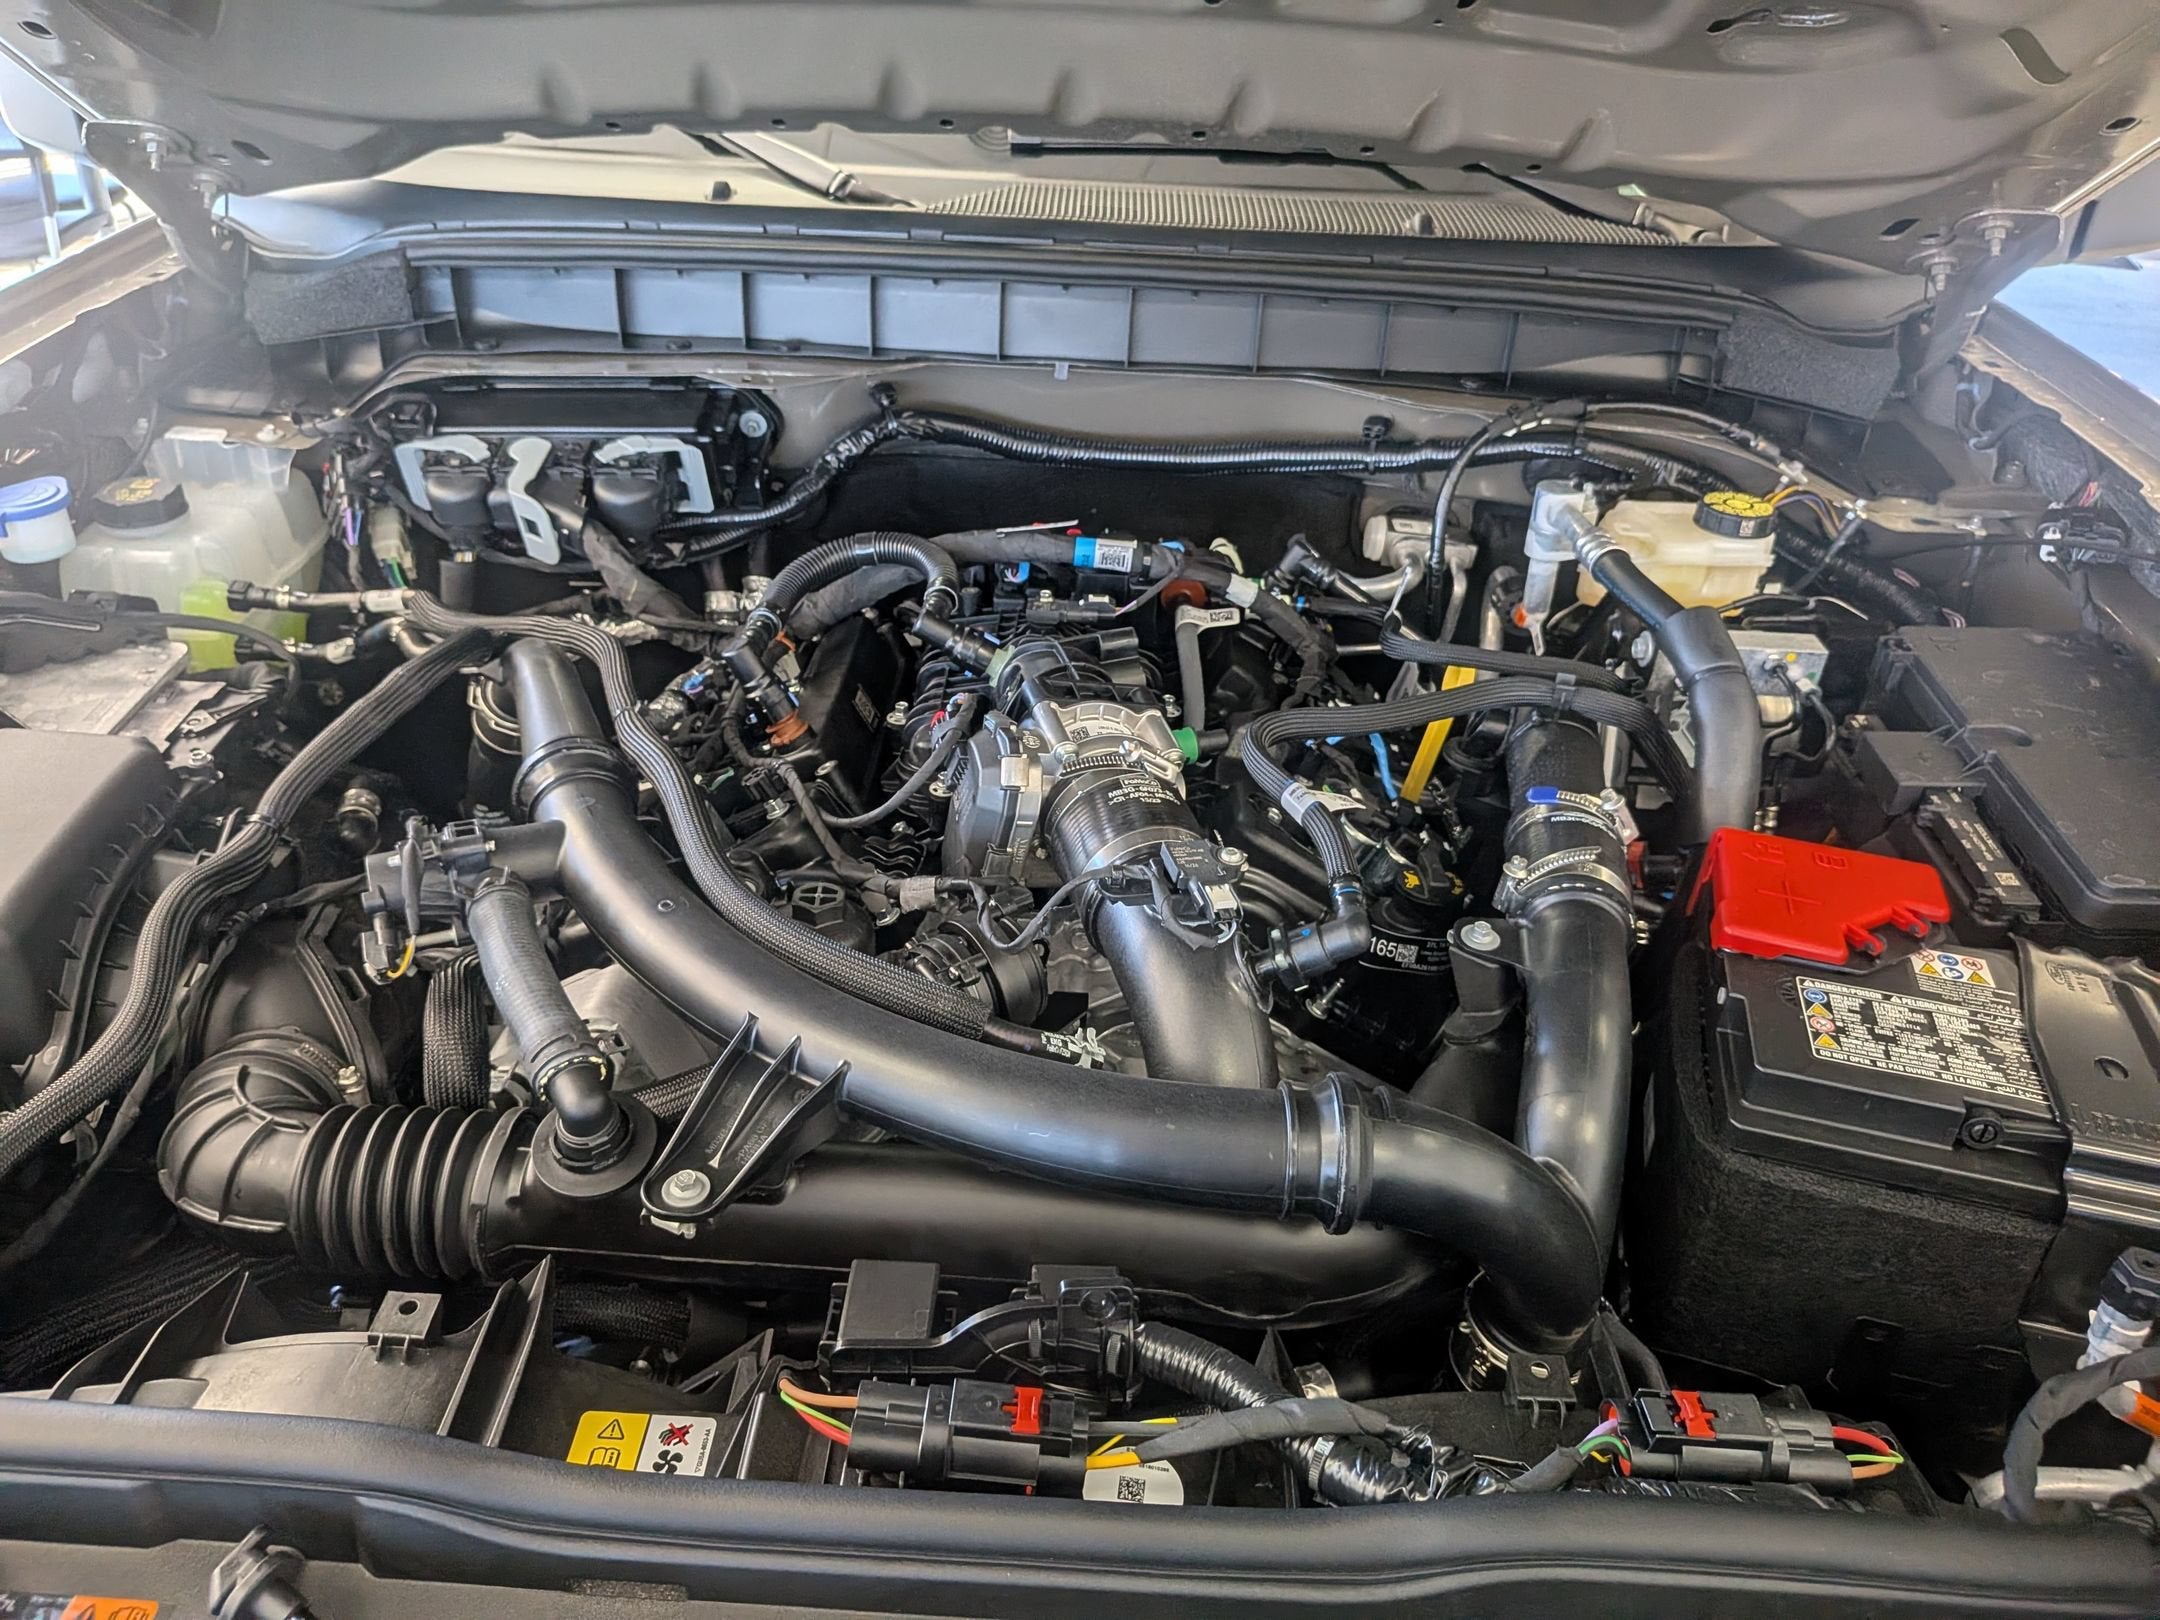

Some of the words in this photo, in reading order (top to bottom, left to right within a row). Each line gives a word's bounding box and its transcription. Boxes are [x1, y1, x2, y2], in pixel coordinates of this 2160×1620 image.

[1370, 936, 1398, 958] 165
[1814, 981, 1882, 1000] DANGER/POISON
[1901, 998, 1970, 1017] PELIGRO/VENENO
[1833, 1052, 1847, 1060] NOT
[1876, 1060, 1887, 1068] NE
[1888, 1061, 1903, 1071] PAS
[1941, 1073, 1954, 1081] NO
[1955, 1075, 1966, 1084] LA
